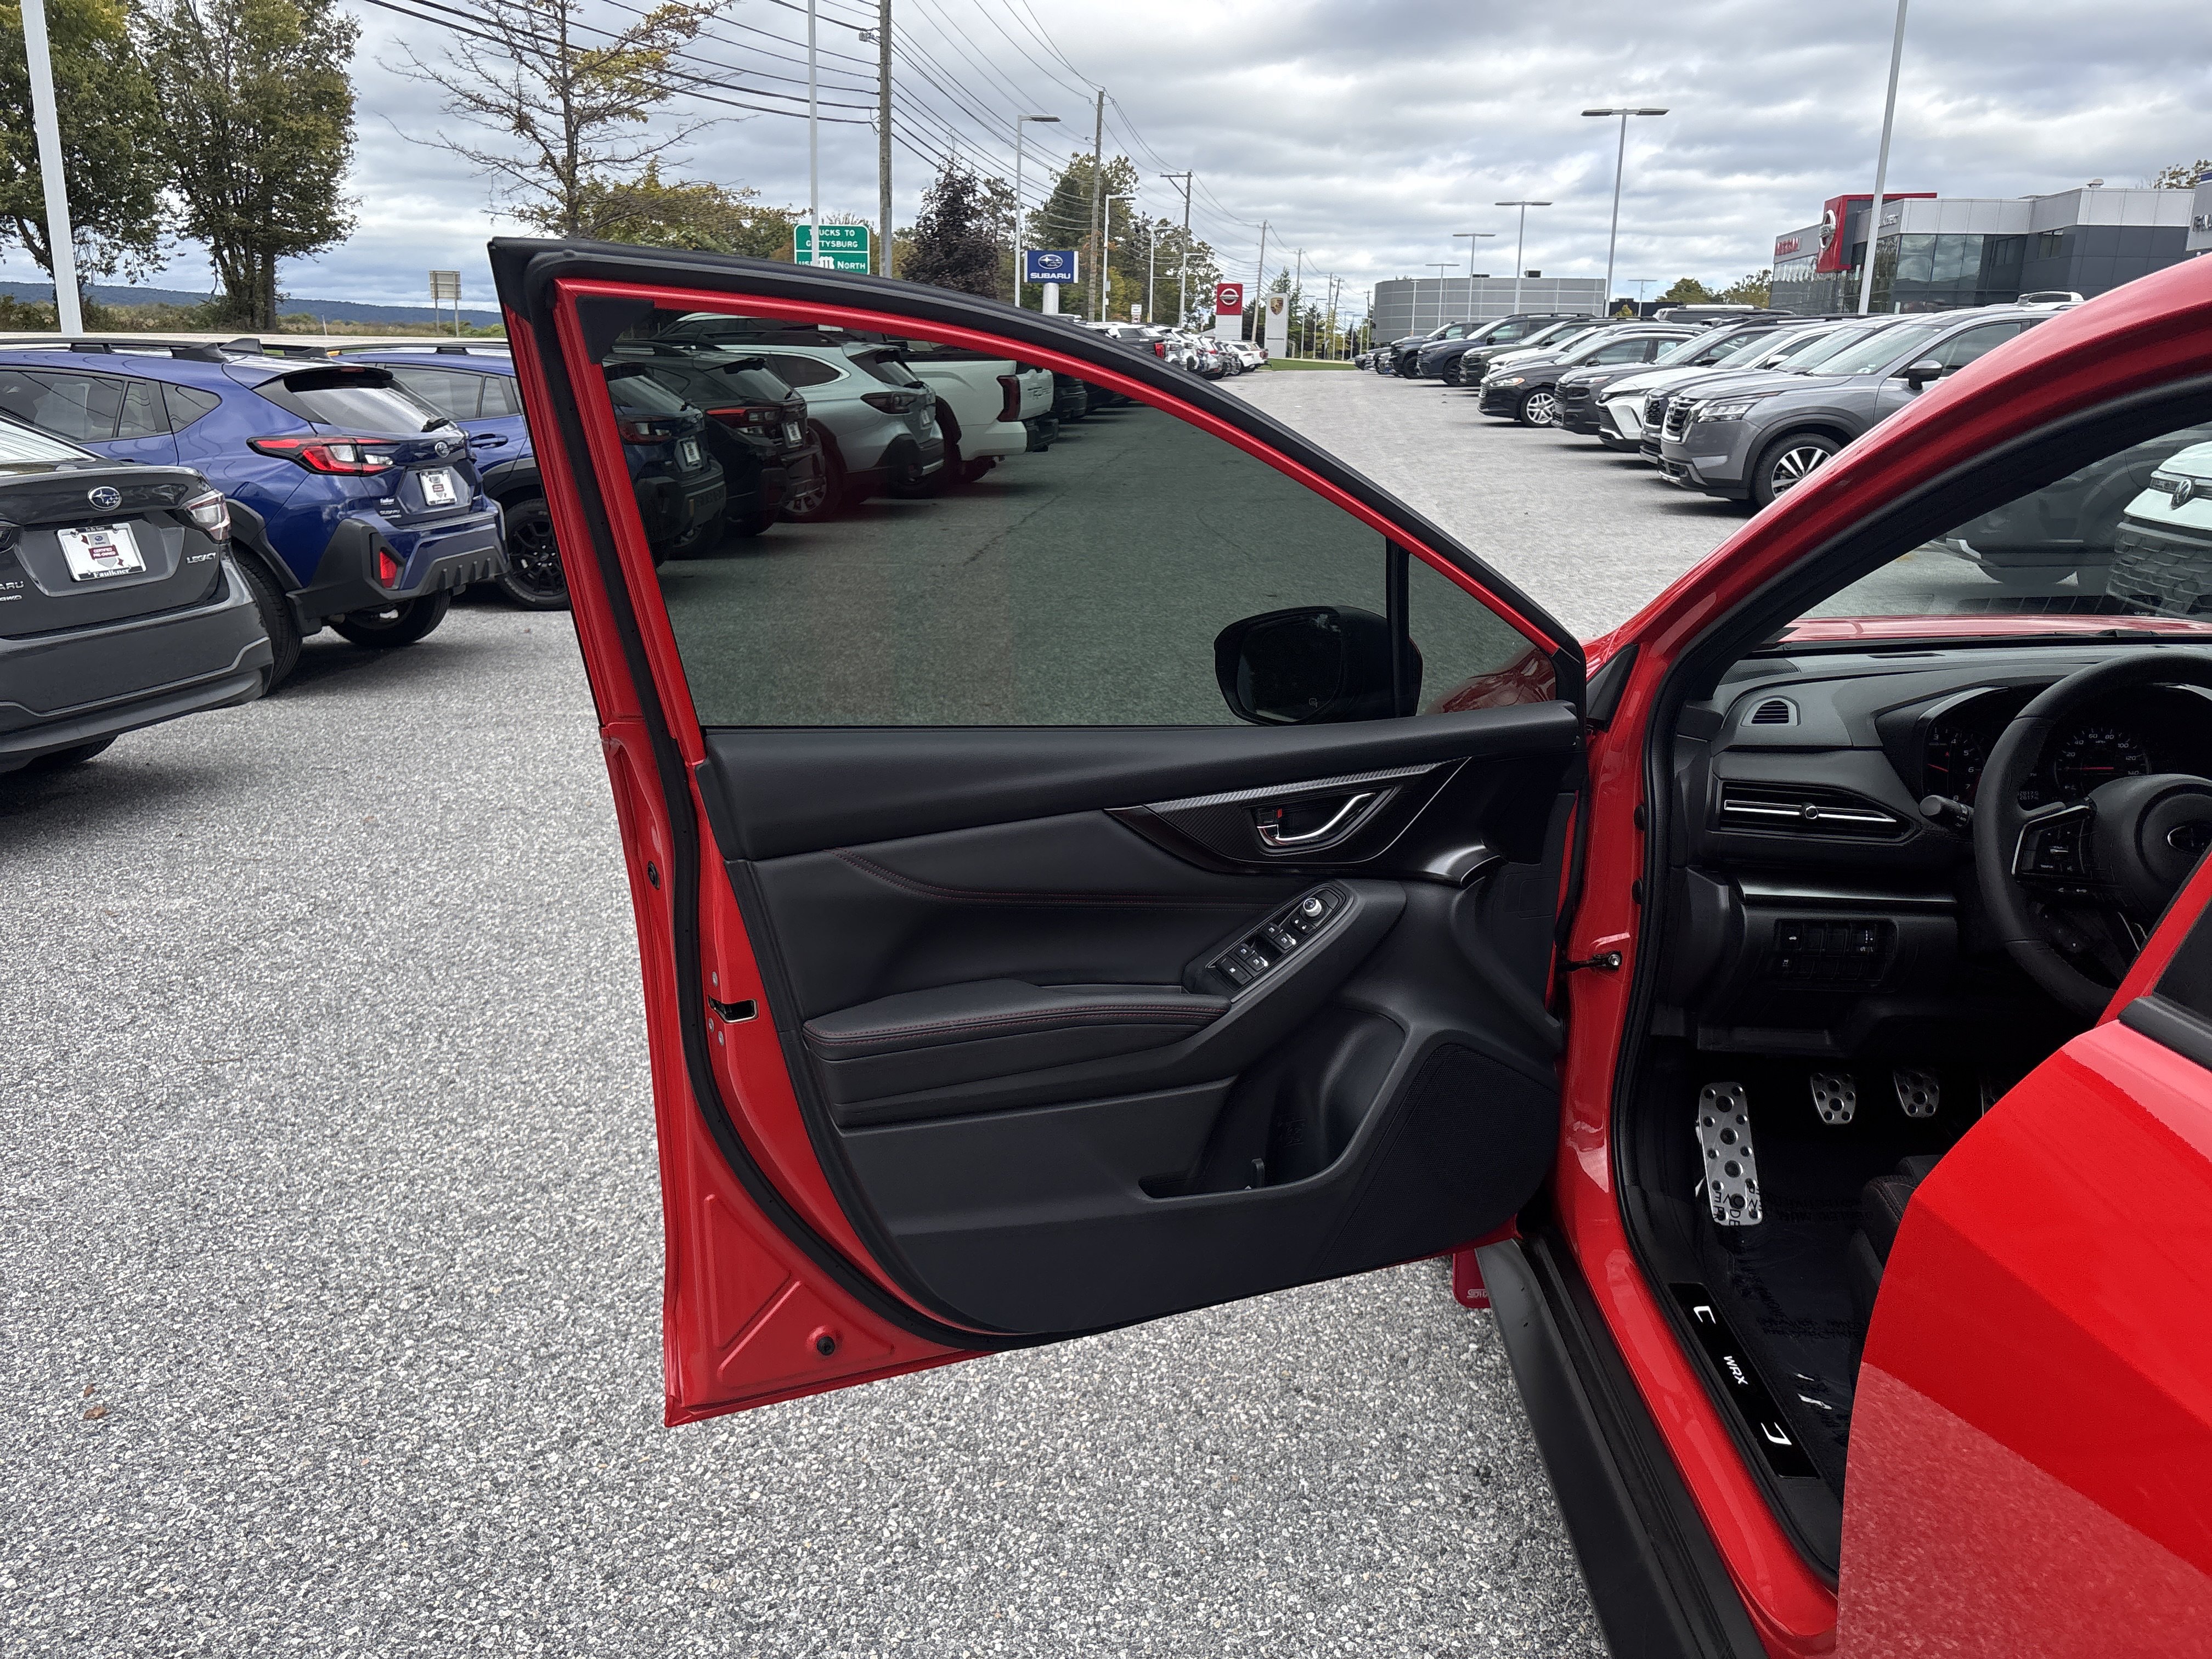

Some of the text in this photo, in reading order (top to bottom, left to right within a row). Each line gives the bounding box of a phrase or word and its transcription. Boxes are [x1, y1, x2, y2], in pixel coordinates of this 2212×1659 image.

[805, 240, 858, 248] GTYSBURG
[837, 261, 866, 269] NORTH
[187, 552, 216, 564] LEGACY
[93, 568, 130, 578] Faulkner
[1723, 1355, 1749, 1385] WRX
